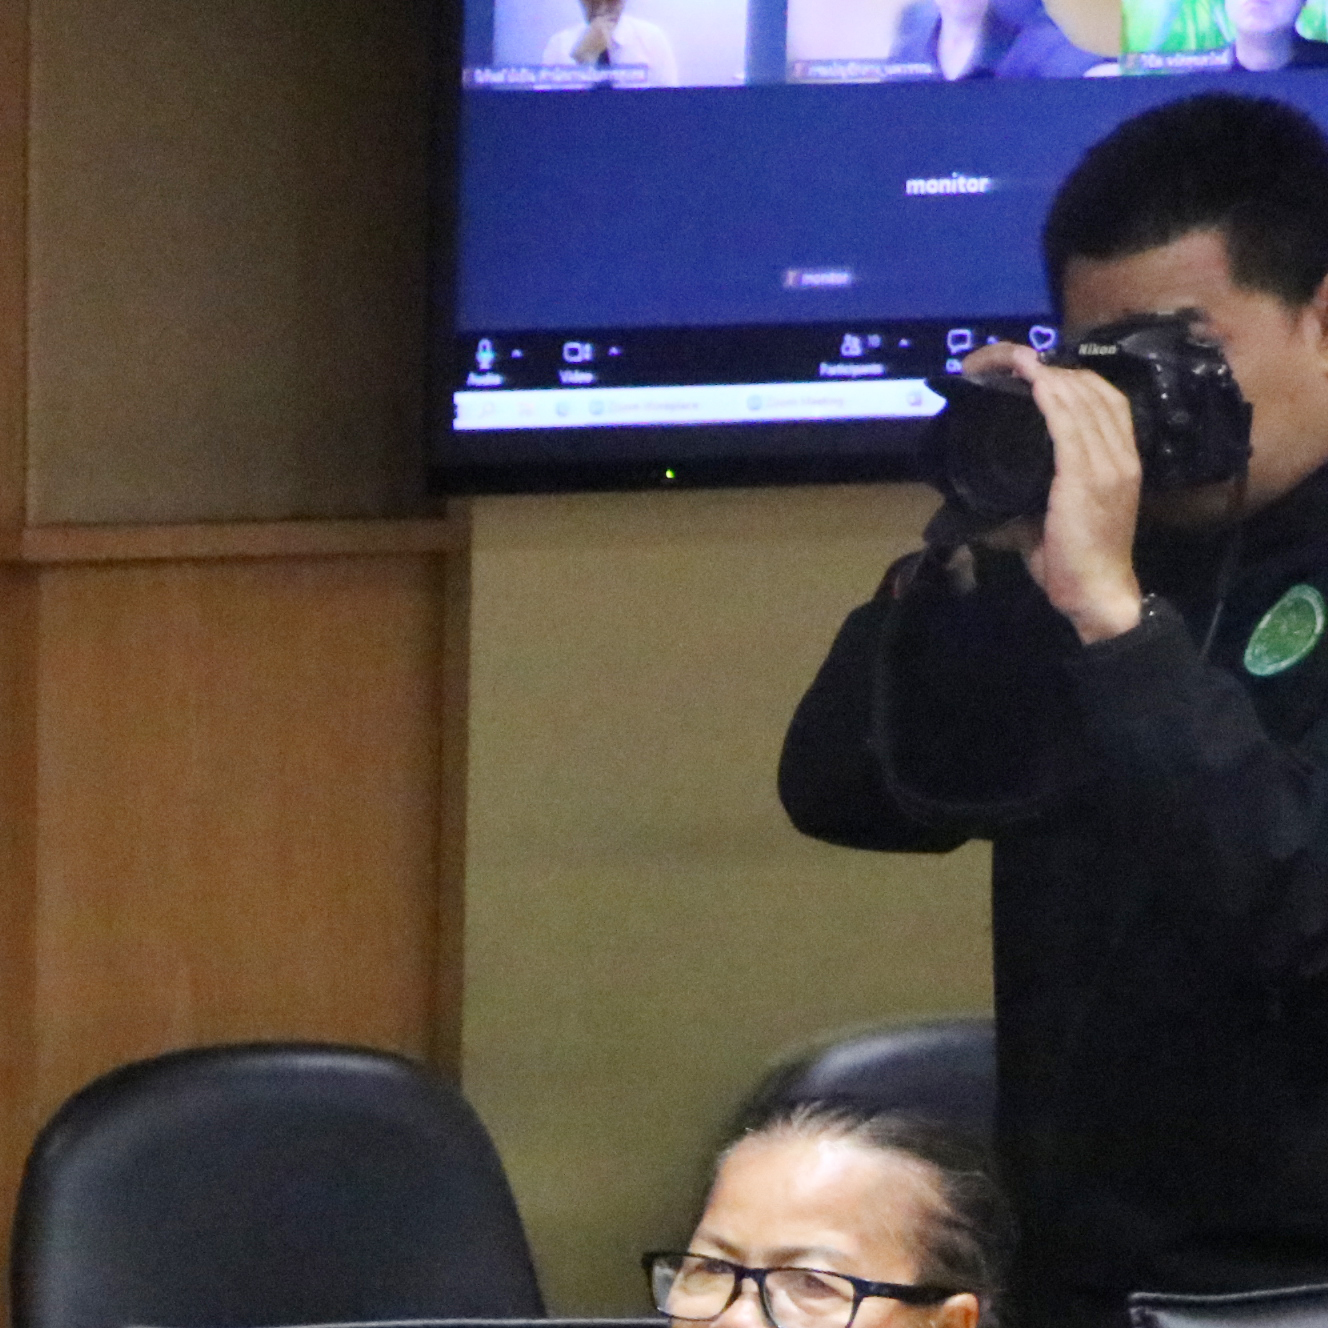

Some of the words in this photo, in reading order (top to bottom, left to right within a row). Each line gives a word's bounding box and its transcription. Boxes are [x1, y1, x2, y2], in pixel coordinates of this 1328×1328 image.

[905, 172, 990, 195] monitor
[1078, 343, 1117, 356] Nikon
[945, 358, 964, 375] Ch
